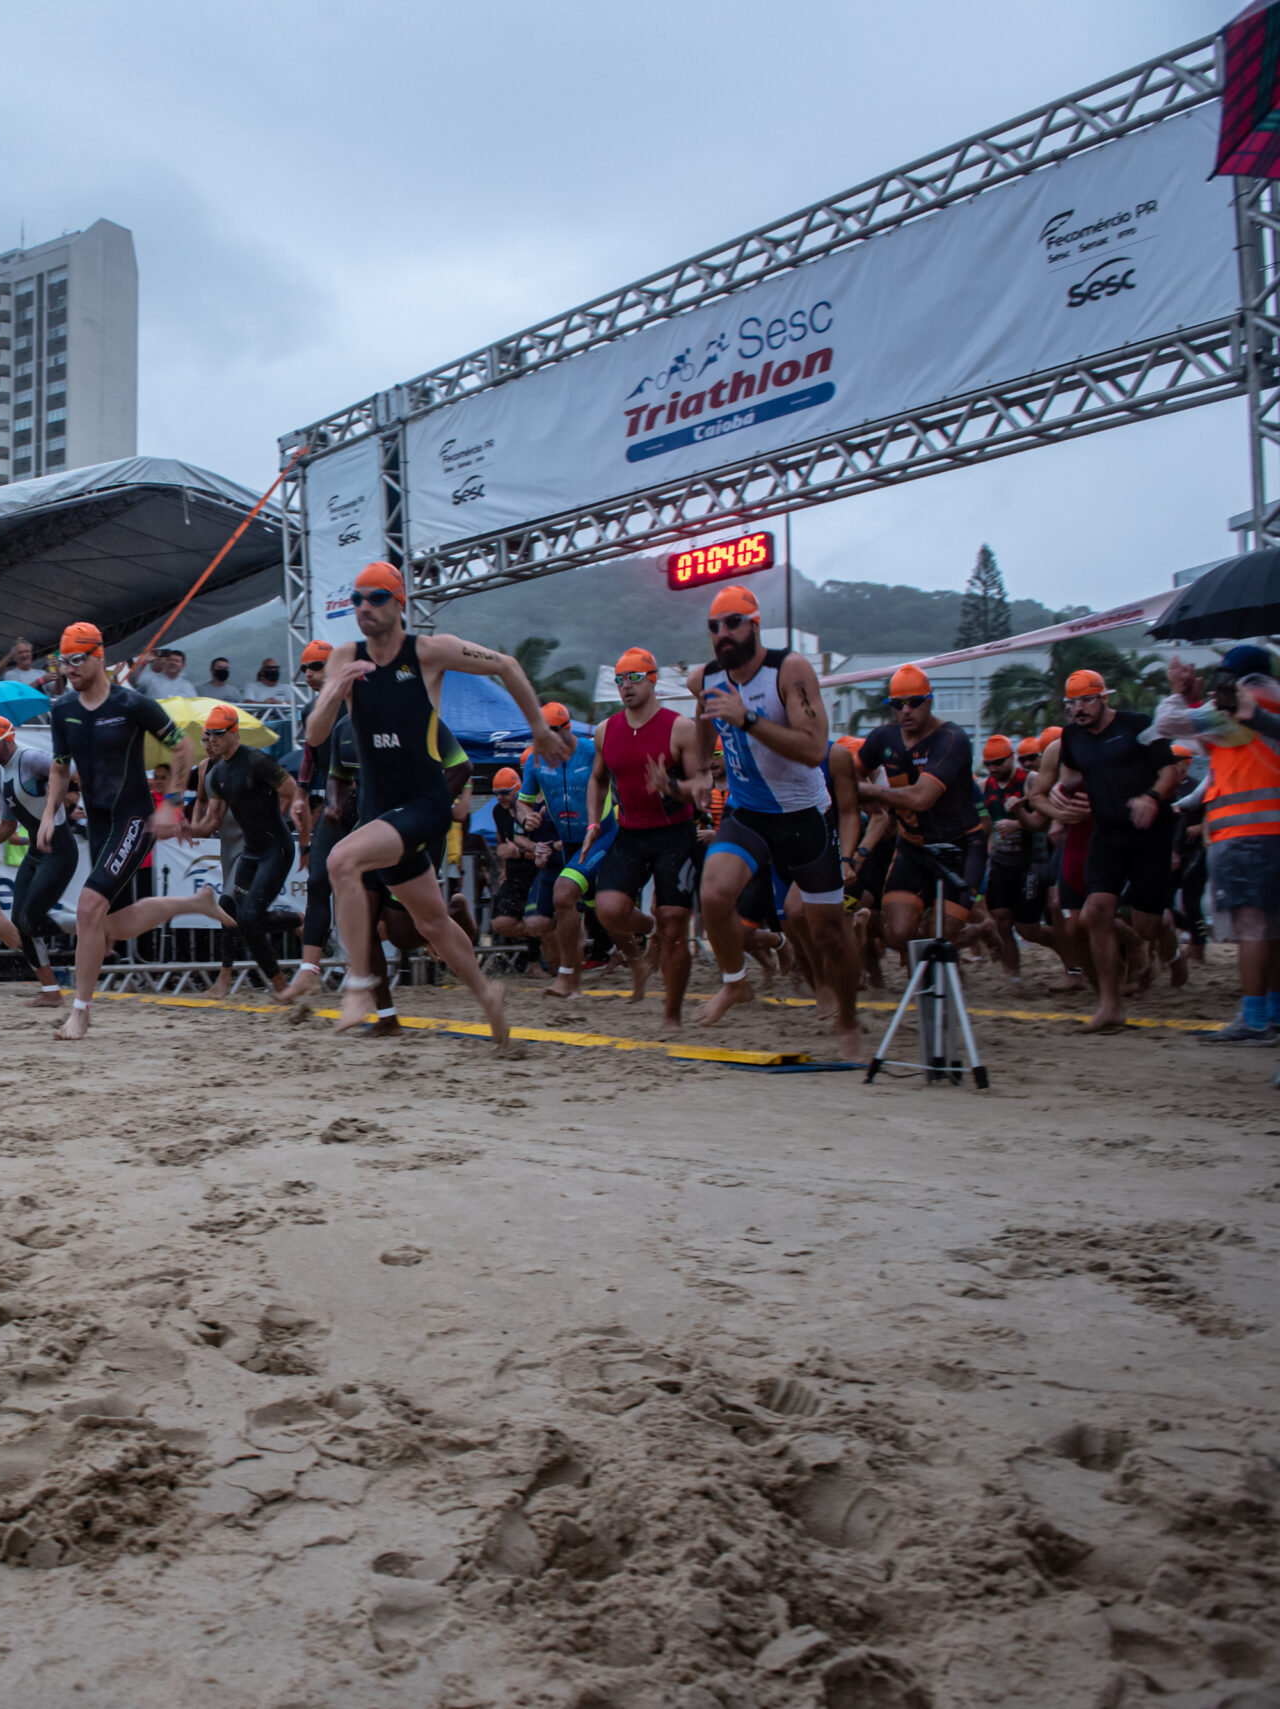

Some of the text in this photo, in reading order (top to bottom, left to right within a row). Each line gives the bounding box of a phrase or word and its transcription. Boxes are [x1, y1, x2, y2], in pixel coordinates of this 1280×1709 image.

[1046, 199, 1158, 250] Fecomércio PR
[738, 301, 833, 359] Sesc
[624, 347, 833, 438] Triathlon
[693, 409, 756, 441] Caiobá
[373, 732, 401, 748] BRA
[110, 818, 142, 877] OLIMPICA
